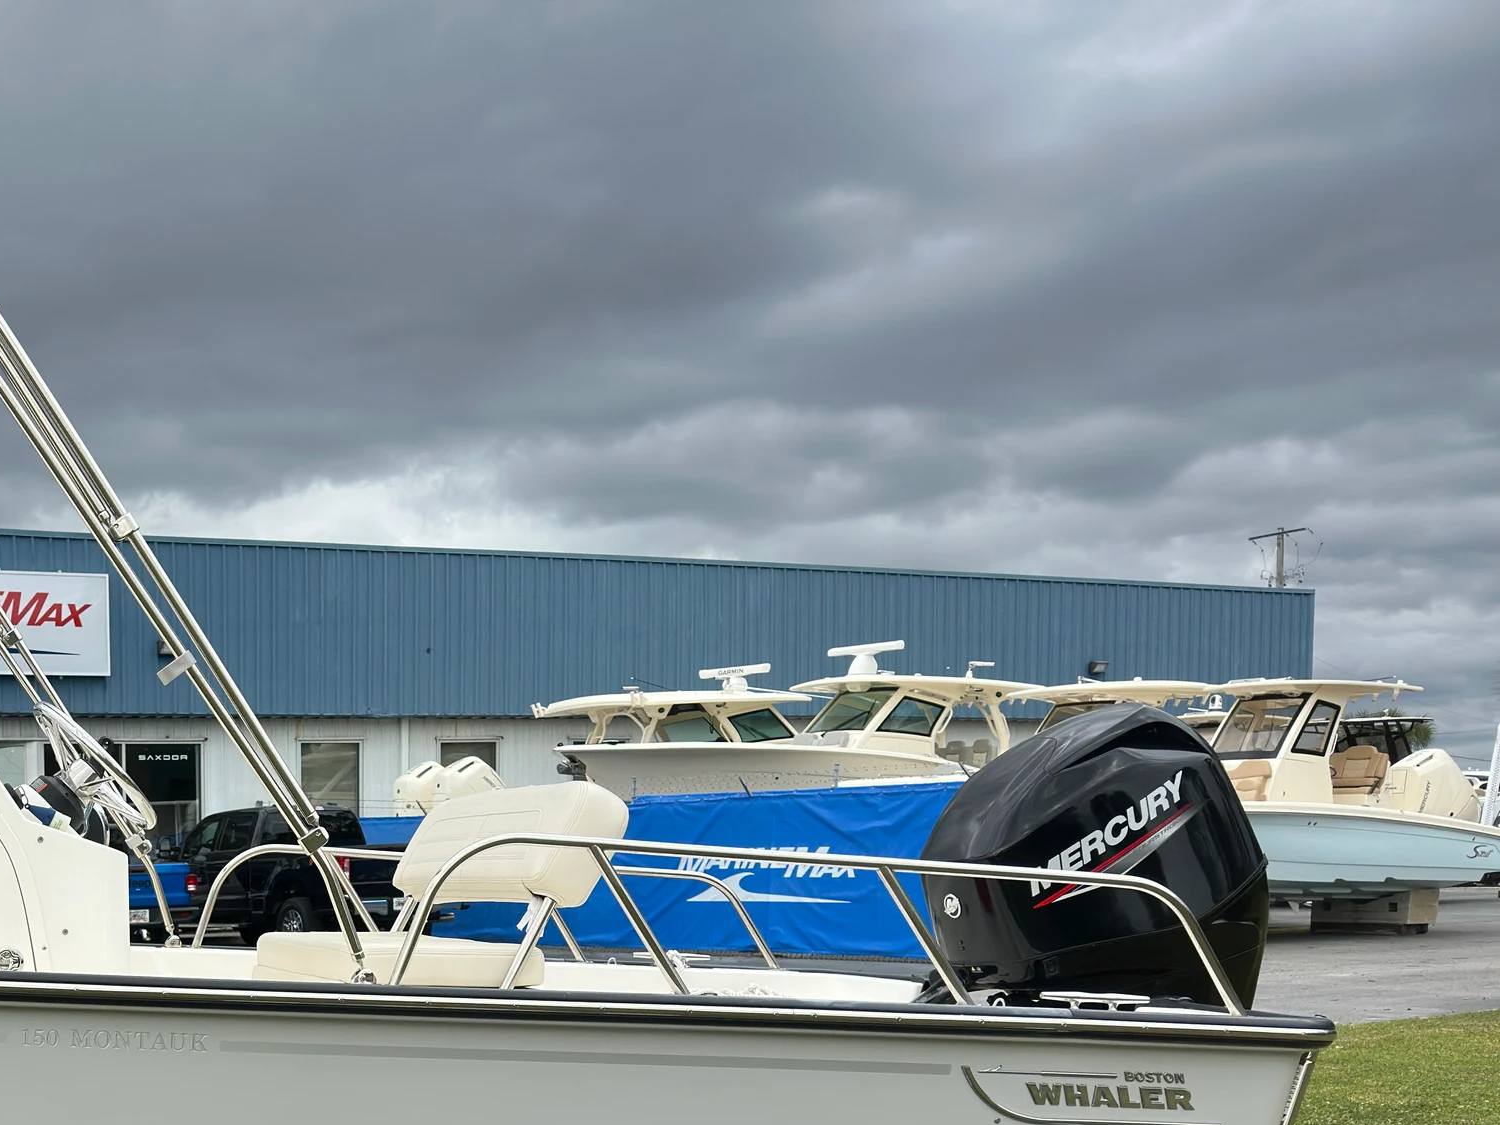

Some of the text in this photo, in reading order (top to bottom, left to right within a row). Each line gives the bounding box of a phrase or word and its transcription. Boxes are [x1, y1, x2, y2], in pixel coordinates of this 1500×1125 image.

[717, 668, 744, 676] GARMIN
[1030, 769, 1183, 898] MERCURY
[21, 1028, 209, 1053] 150 MONTAUK
[1123, 1070, 1185, 1084] BOSTON
[1025, 1081, 1195, 1111] WHALER
